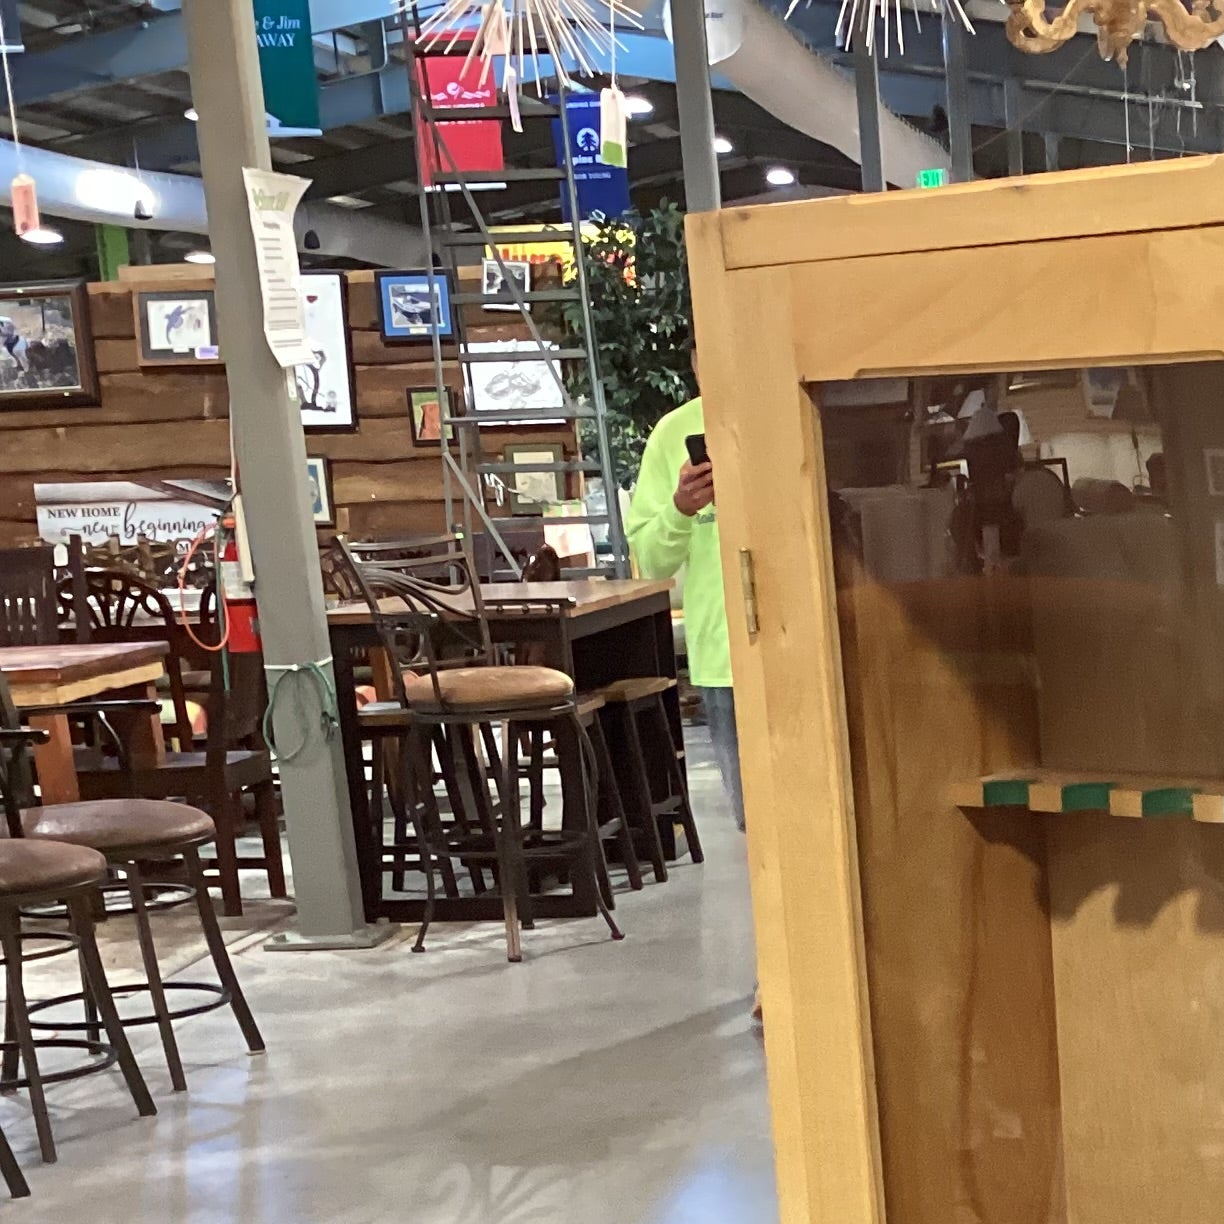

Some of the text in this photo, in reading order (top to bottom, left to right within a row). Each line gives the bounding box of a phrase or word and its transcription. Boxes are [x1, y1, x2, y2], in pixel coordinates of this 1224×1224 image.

[262, 15, 275, 30] &
[276, 15, 301, 30] Jim
[48, 507, 121, 519] NEW HOME
